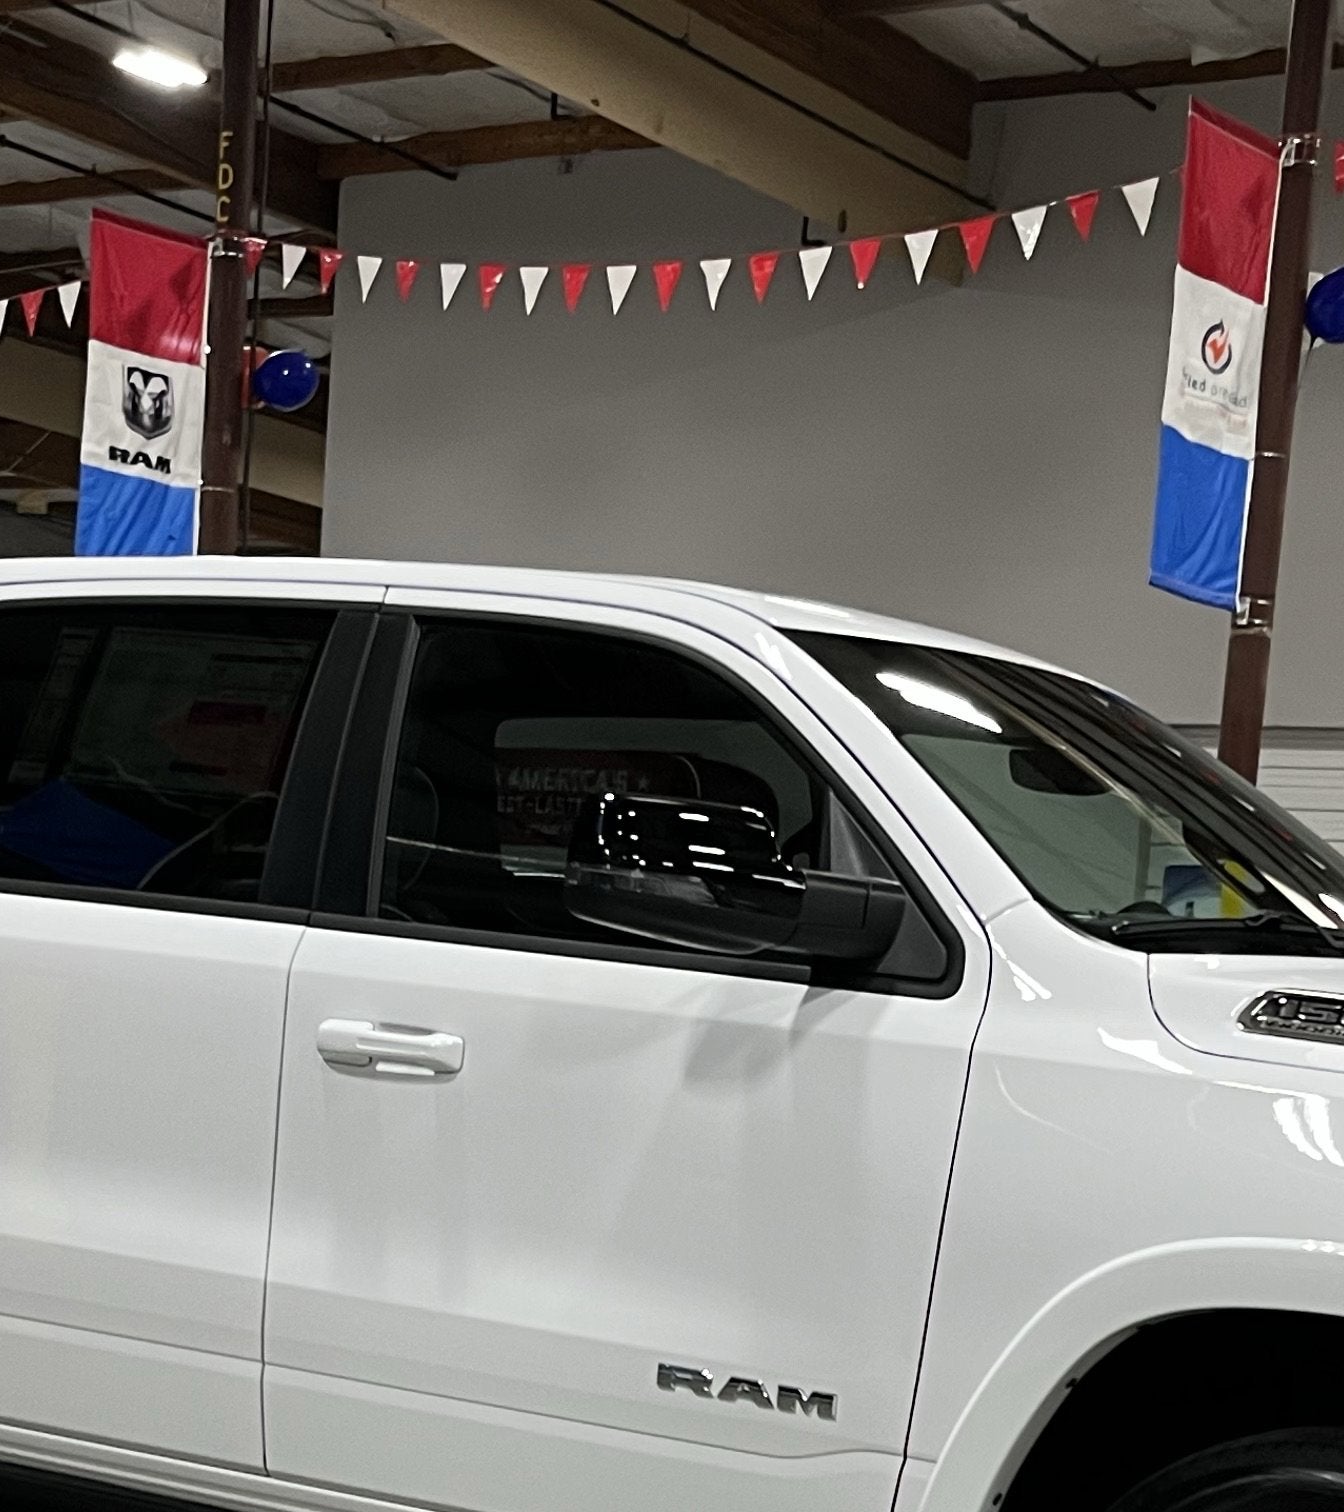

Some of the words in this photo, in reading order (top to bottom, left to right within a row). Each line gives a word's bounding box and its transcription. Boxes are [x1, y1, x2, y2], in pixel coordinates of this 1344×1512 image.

[217, 131, 234, 222] FDC
[108, 445, 171, 474] RAM
[657, 1362, 838, 1422] RAM
